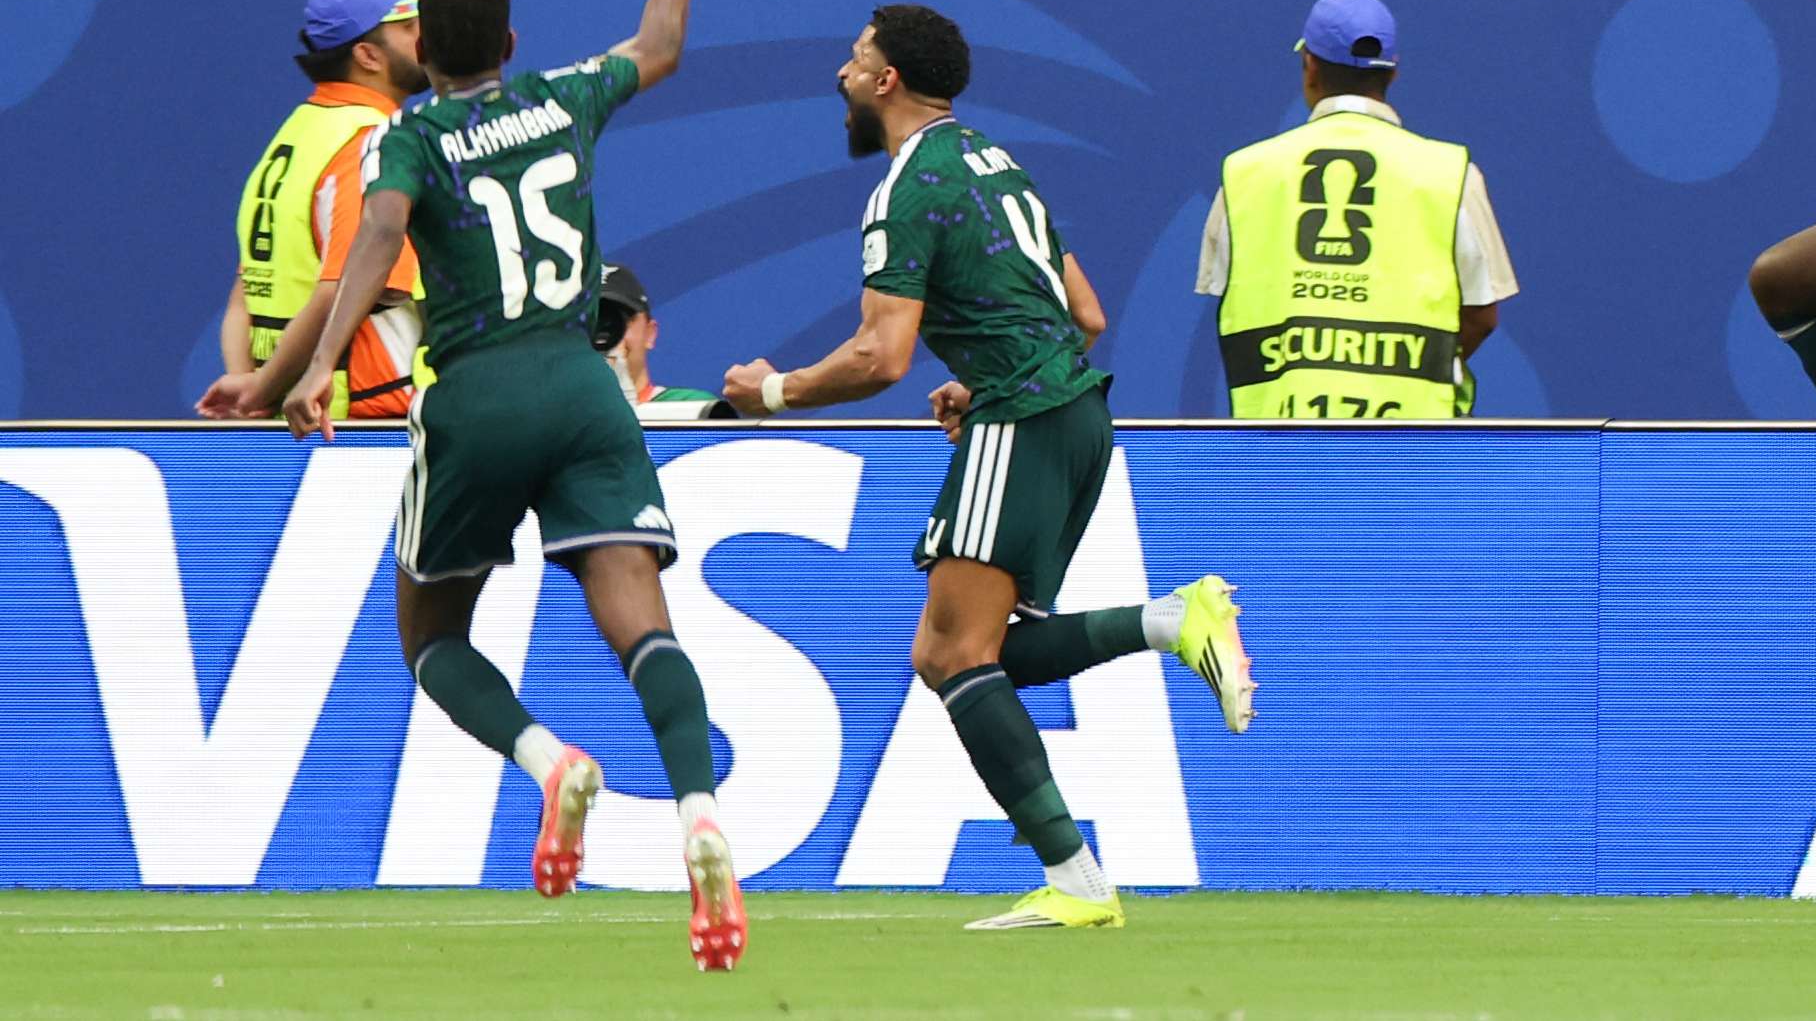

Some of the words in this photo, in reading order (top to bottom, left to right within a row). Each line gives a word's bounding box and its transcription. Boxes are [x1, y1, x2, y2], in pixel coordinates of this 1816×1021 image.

[468, 152, 585, 320] 15
[1314, 241, 1355, 257] FIFA
[1293, 270, 1340, 281] WORLD
[1343, 273, 1370, 283] CUP
[1292, 283, 1369, 303] 2026
[1260, 327, 1426, 372] SCURITY
[0, 439, 1200, 890] VISA
